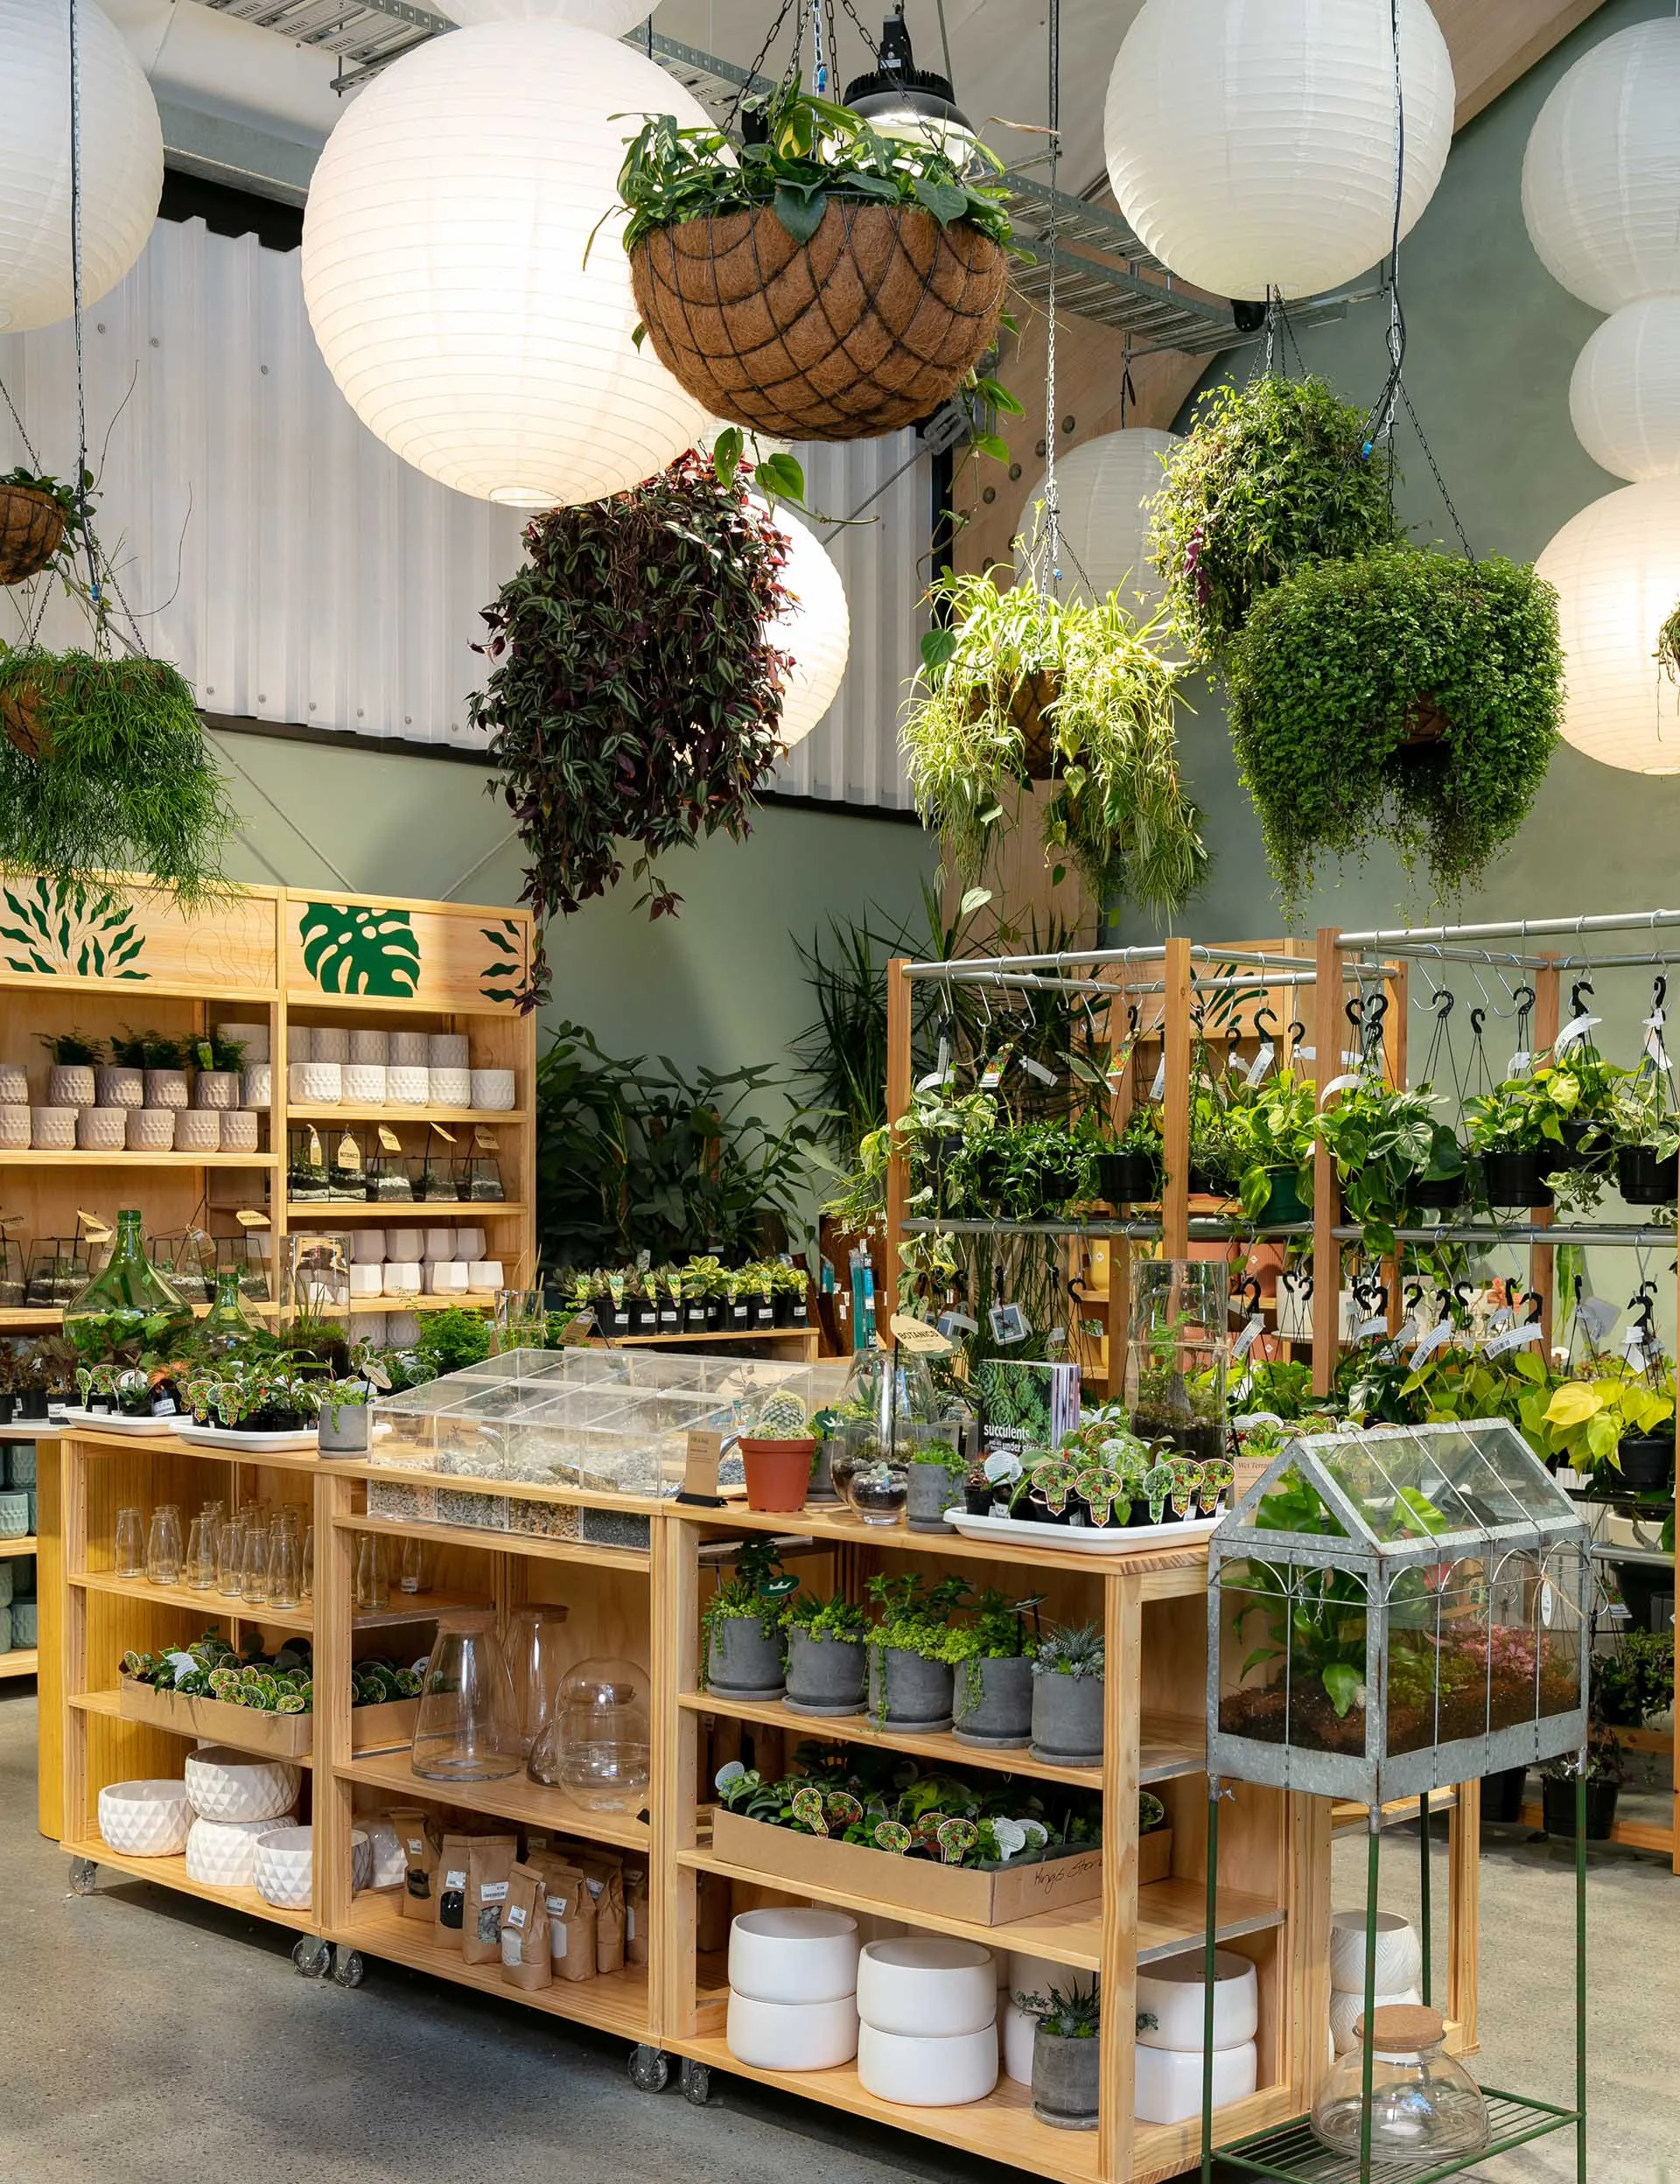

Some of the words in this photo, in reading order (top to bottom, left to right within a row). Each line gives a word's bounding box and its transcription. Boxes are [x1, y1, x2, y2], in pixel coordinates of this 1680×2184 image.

[897, 1330, 939, 1340] BOTANICS
[984, 1424, 1031, 1440] succulents
[1002, 1441, 1021, 1452] under
